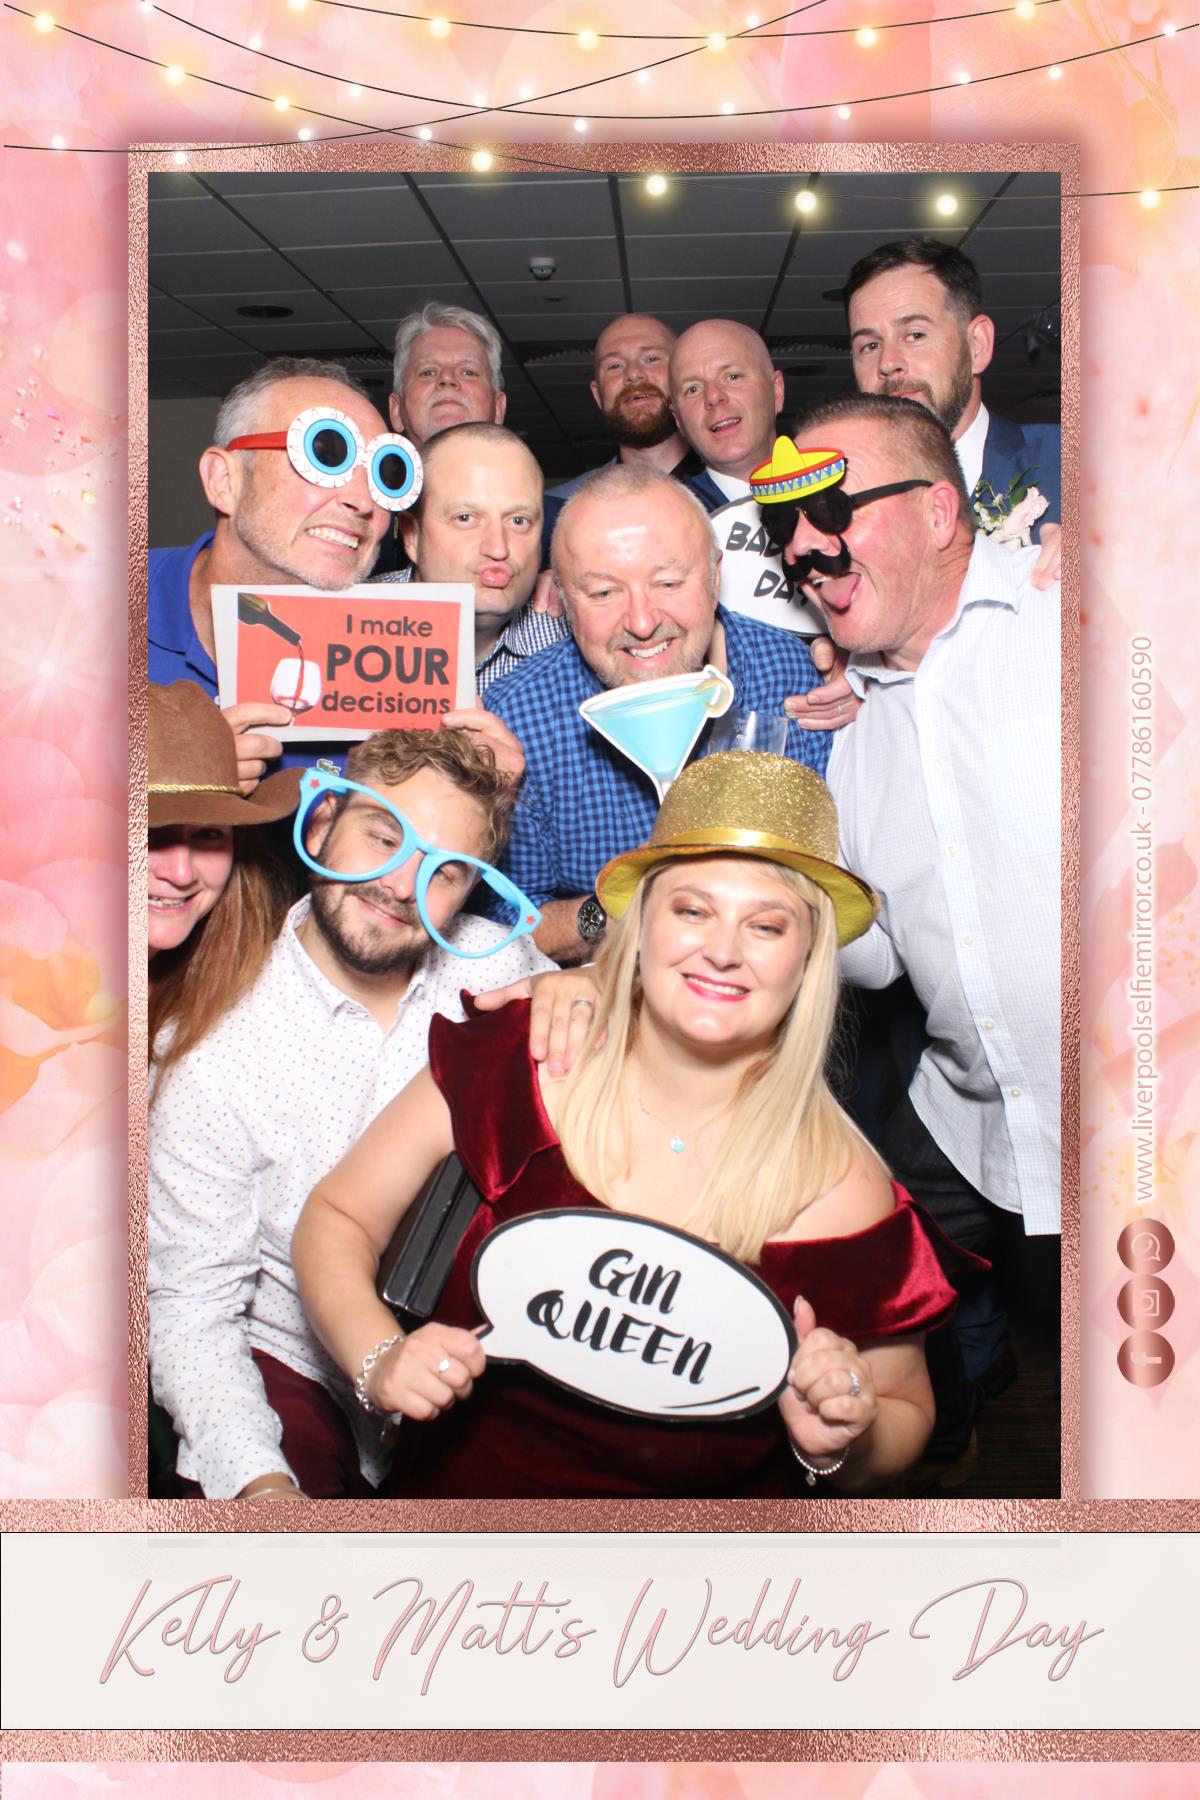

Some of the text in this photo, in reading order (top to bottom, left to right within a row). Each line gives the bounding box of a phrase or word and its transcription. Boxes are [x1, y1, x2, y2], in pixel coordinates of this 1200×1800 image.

[346, 614, 433, 637] I make
[326, 643, 450, 686] POUR
[321, 690, 450, 715] decisions
[588, 1248, 682, 1314] GIN
[526, 1289, 712, 1385] QUEEN
